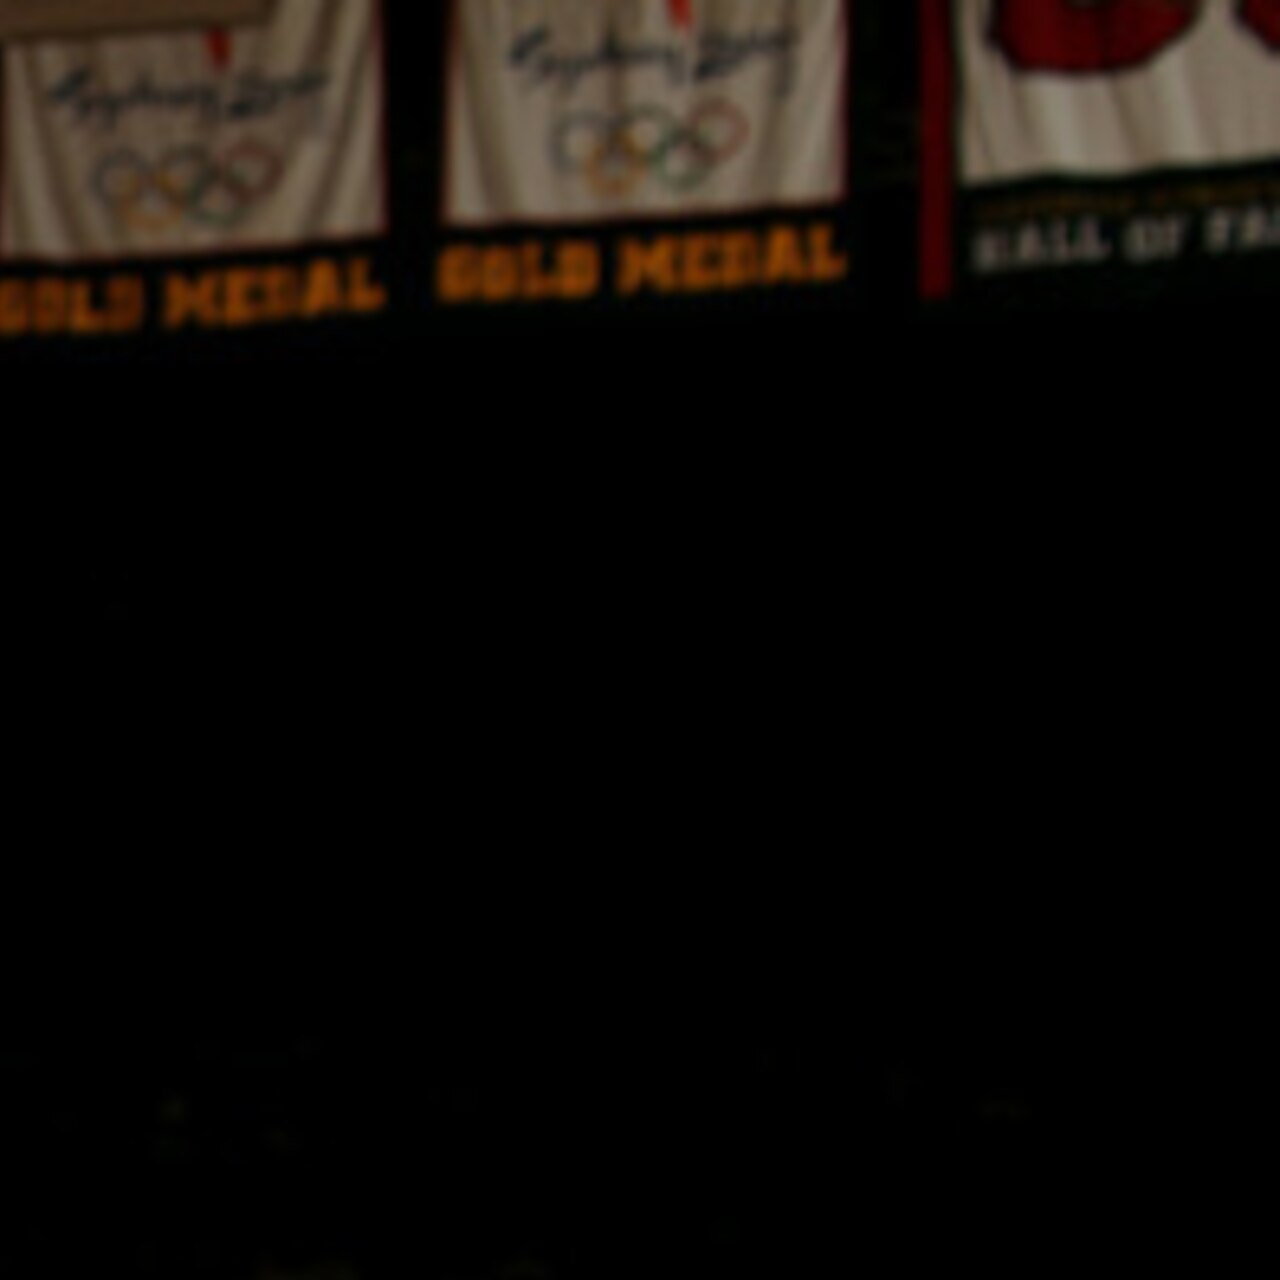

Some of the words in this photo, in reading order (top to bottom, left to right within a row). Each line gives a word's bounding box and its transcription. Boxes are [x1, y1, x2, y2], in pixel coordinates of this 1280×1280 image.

[434, 234, 602, 310] GOLD
[613, 217, 849, 299] MEDAL
[968, 214, 1114, 278] HALL
[1123, 210, 1193, 264] OF
[157, 253, 388, 334] MEDAL
